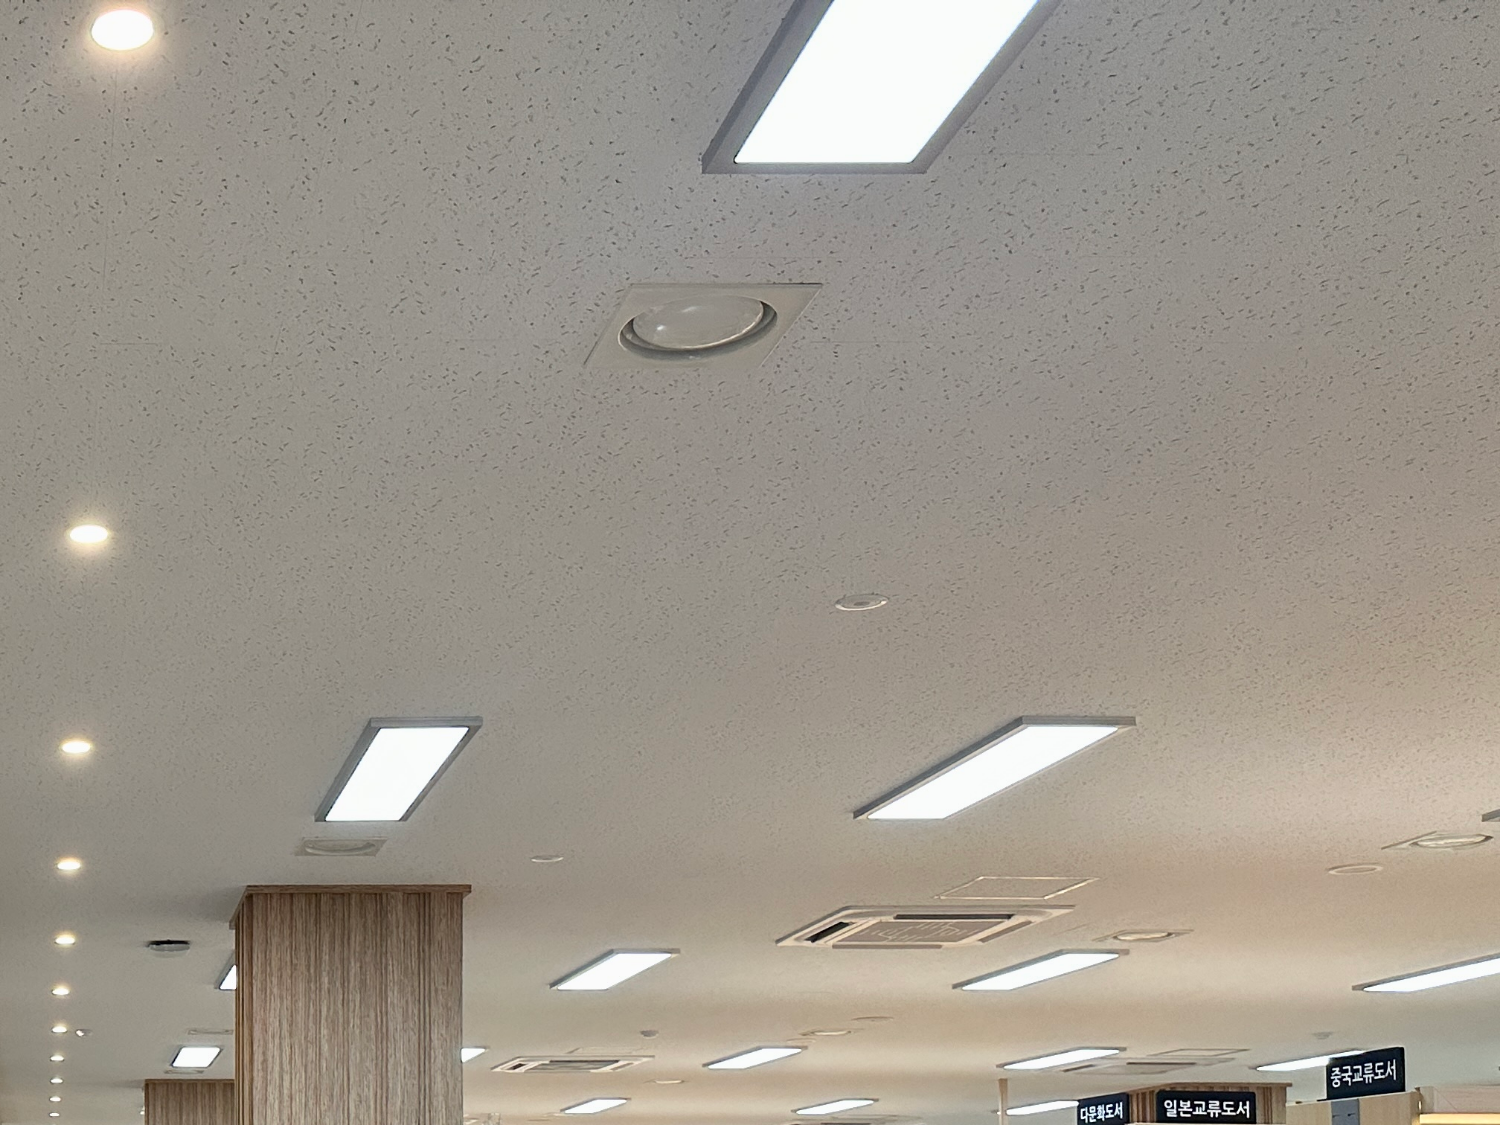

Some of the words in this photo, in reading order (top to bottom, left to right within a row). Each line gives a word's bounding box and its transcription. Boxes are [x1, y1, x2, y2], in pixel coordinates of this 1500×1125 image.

[1330, 1058, 1397, 1088] 중국교류도서
[1080, 1102, 1123, 1123] 다문화도서
[1164, 1099, 1250, 1118] 일본교류도서
